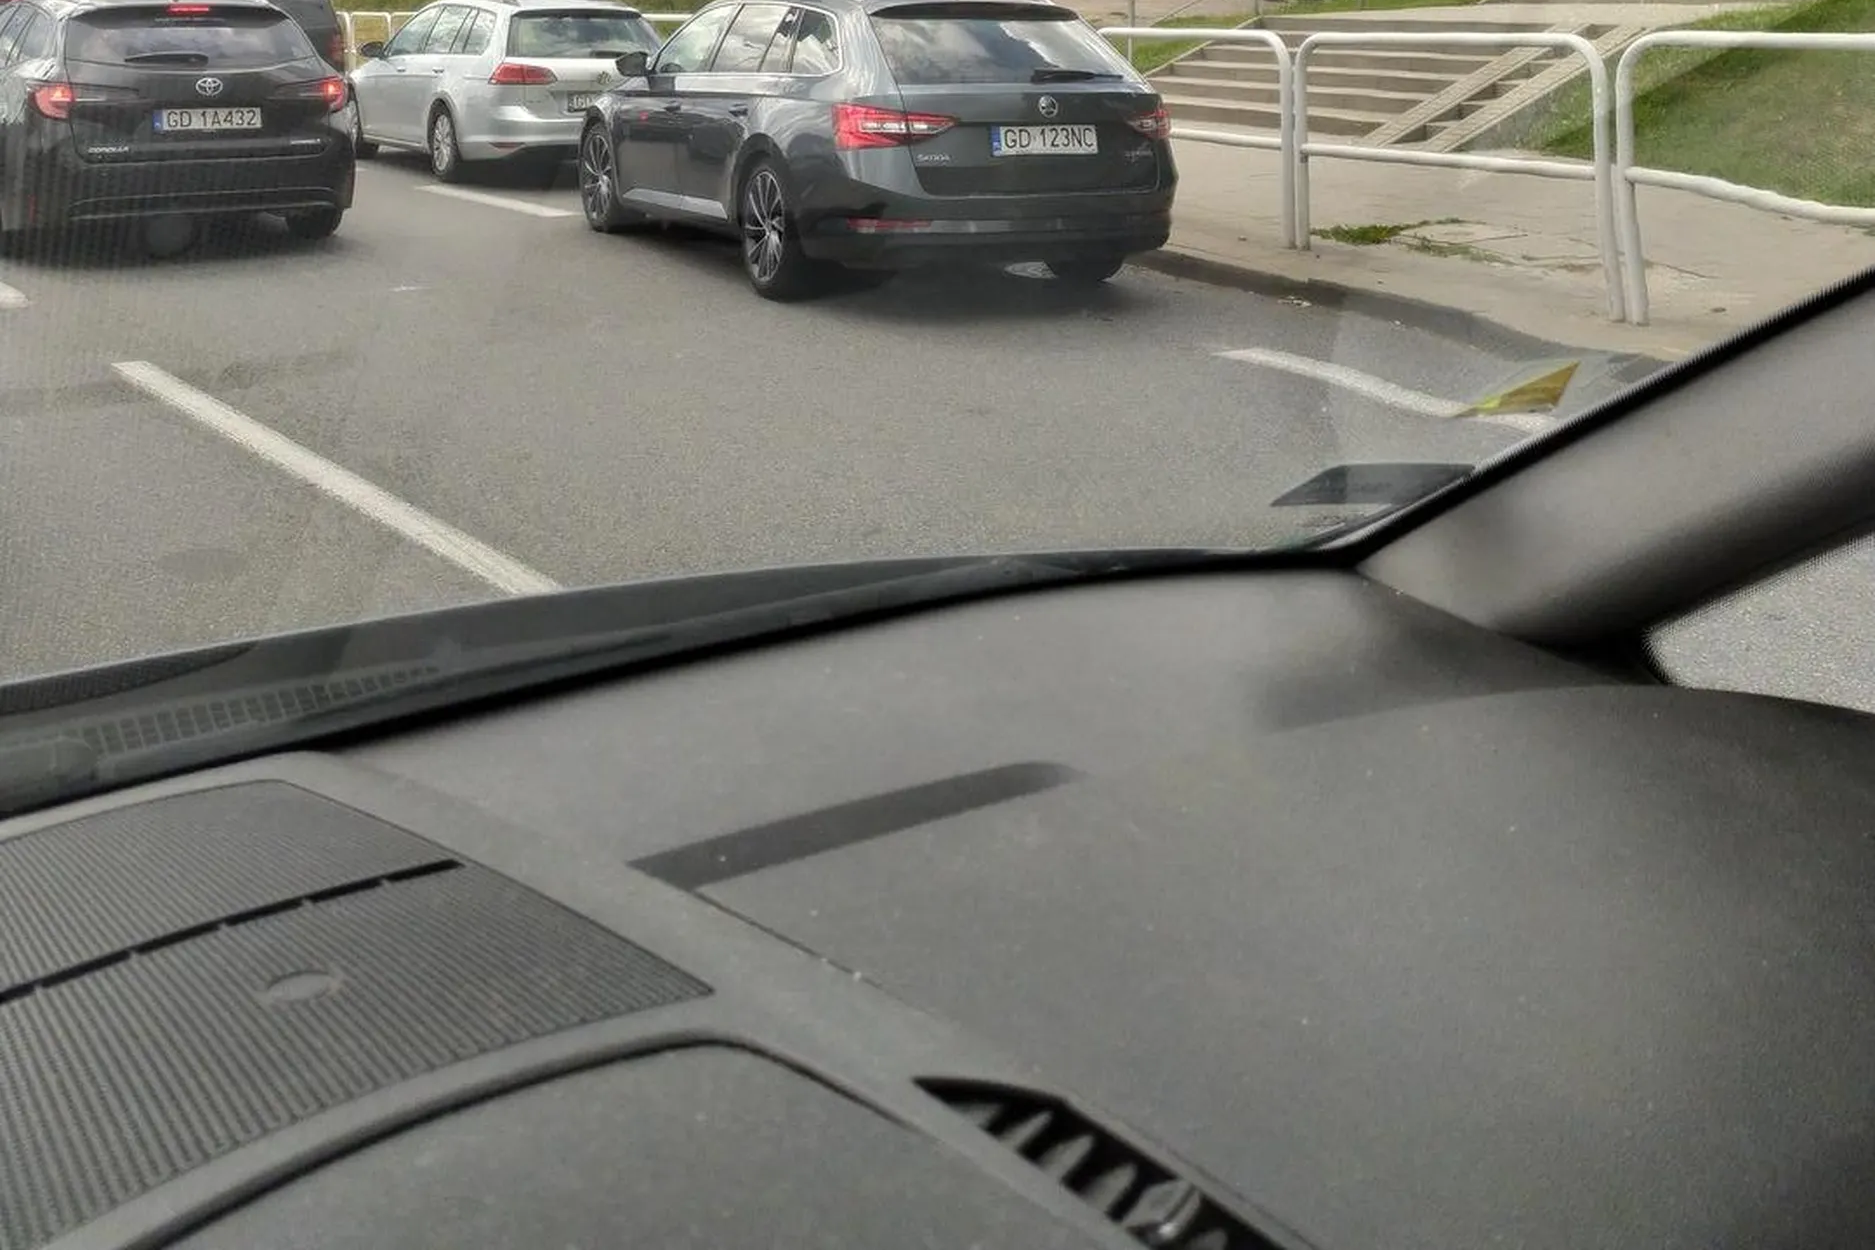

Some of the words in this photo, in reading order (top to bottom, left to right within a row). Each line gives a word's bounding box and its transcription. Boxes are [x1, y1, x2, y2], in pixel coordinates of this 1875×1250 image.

[166, 110, 192, 128] GD
[201, 108, 258, 127] 1A432
[1003, 128, 1032, 149] GD
[1040, 126, 1095, 148] 123NC
